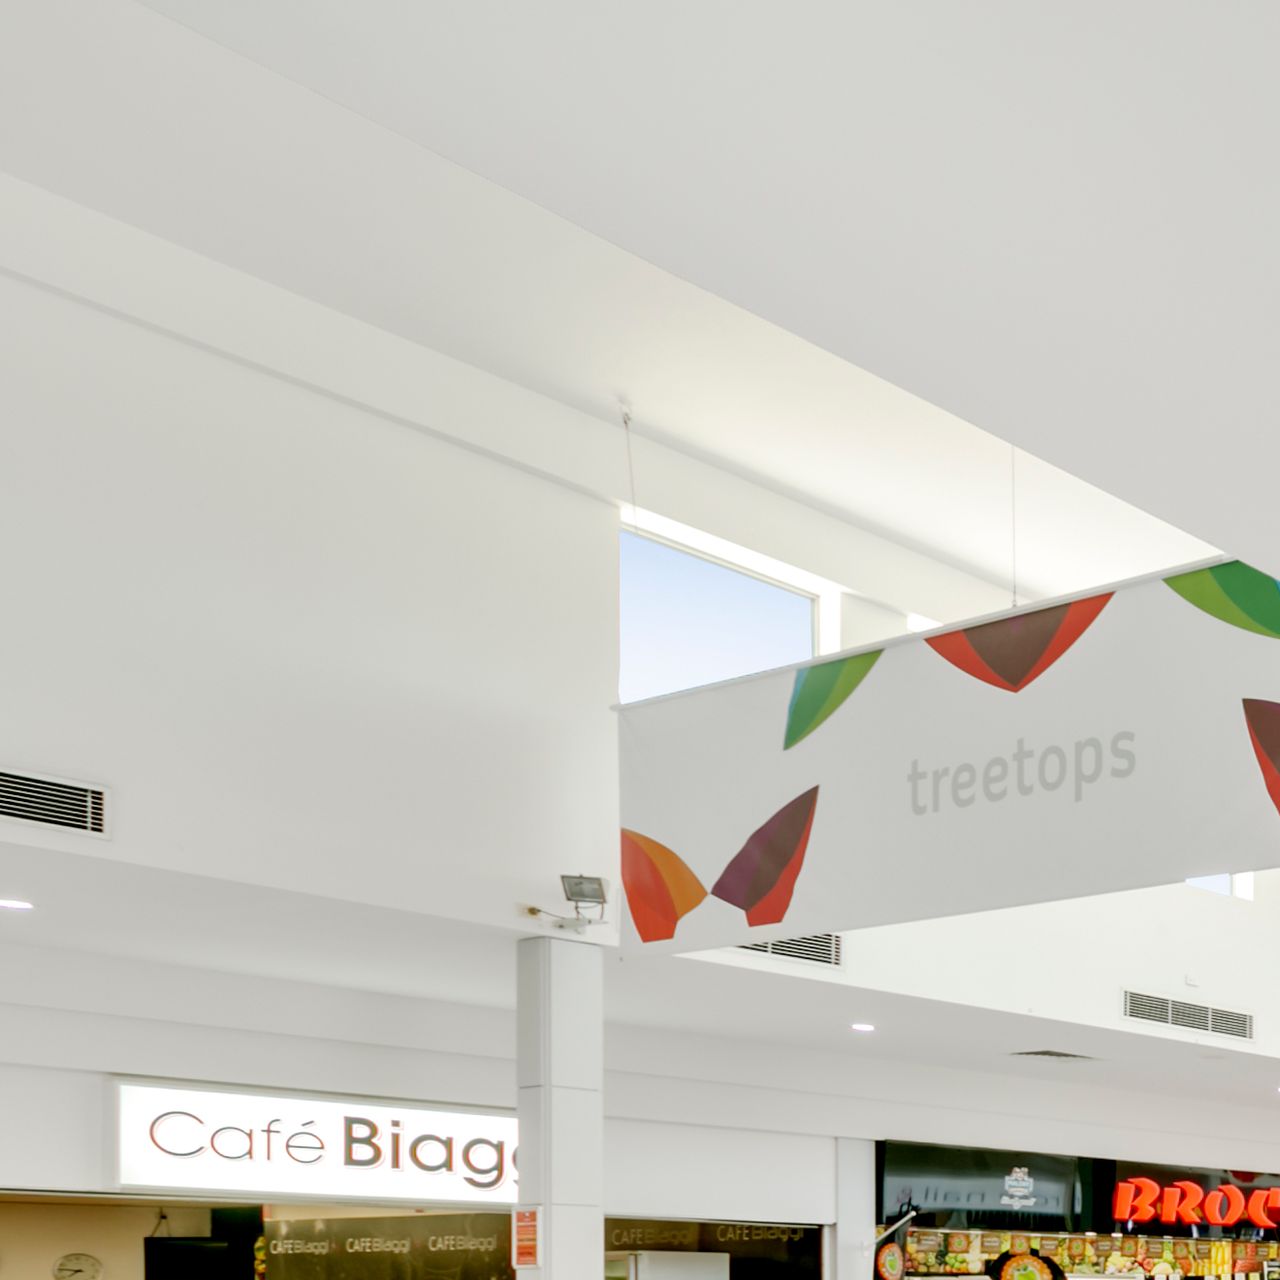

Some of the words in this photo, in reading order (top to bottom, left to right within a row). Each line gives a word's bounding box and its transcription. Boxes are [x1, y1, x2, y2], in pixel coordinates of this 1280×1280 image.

[907, 730, 1136, 816] treetops
[149, 1110, 326, 1165] Café
[343, 1115, 518, 1191] Biag
